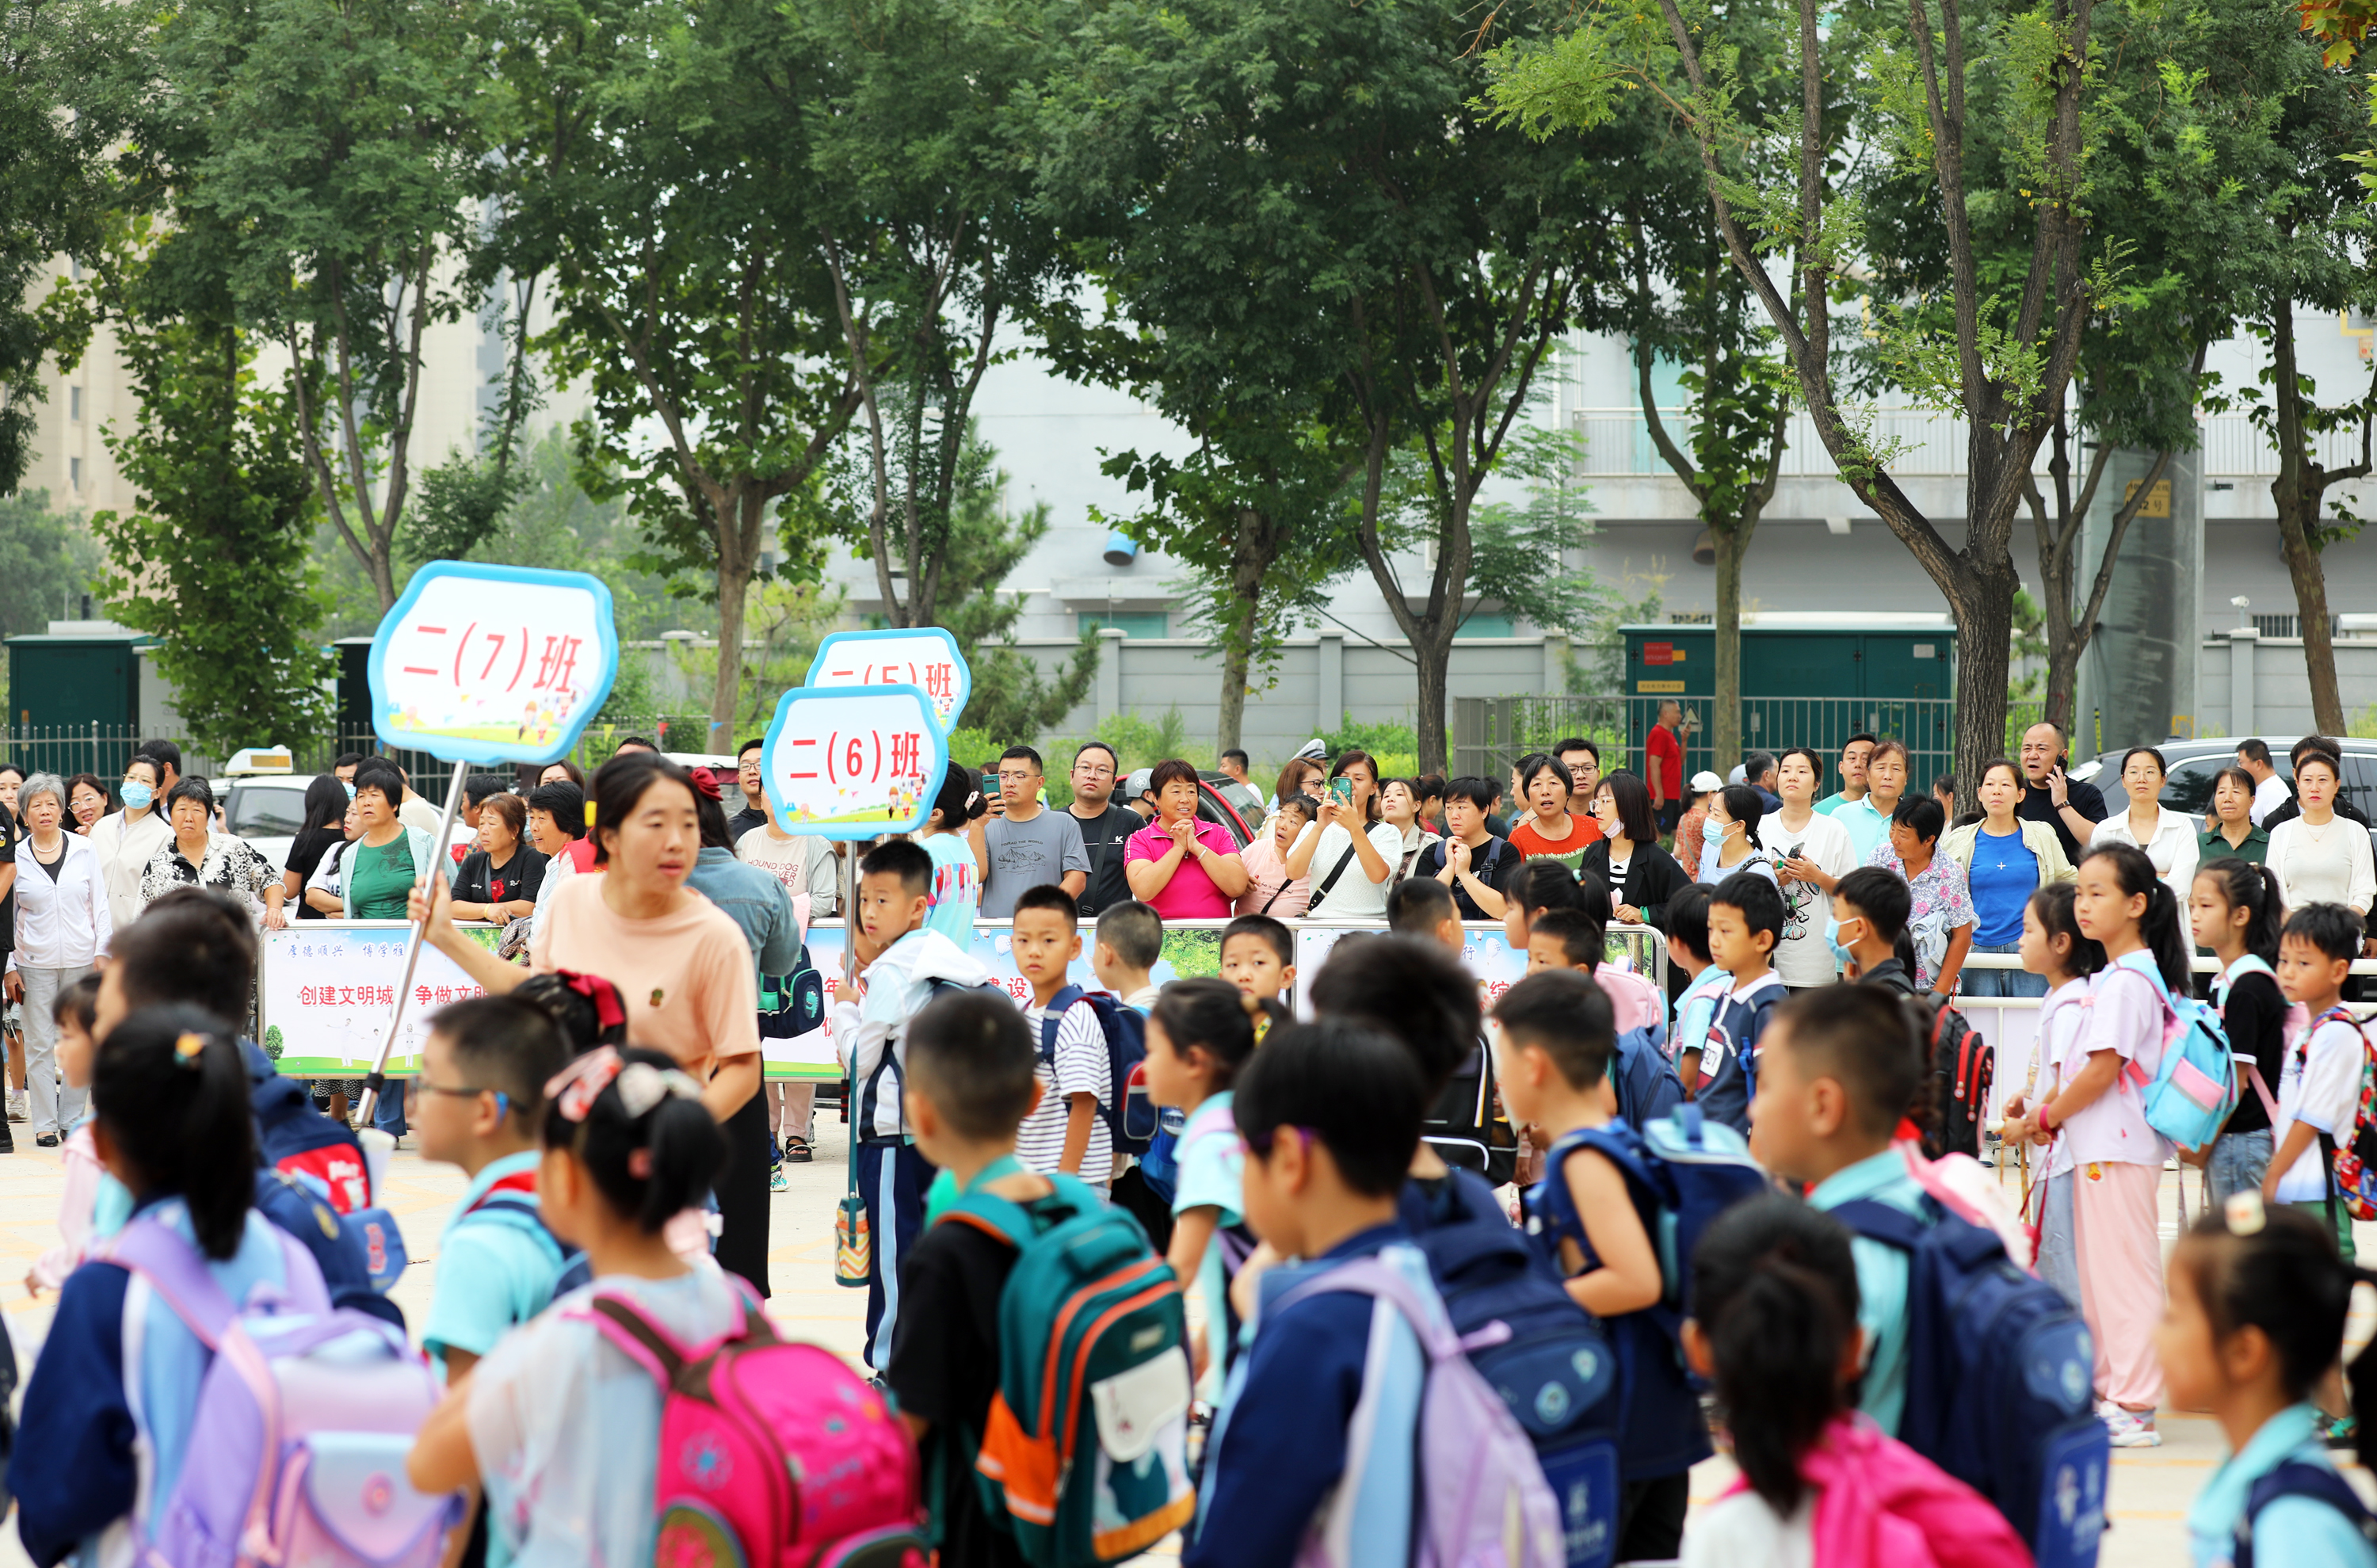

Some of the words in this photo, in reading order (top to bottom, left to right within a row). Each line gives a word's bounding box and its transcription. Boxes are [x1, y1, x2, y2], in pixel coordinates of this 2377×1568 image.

[403, 622, 582, 692] 二(7)班
[790, 730, 921, 784] 二(6)班
[747, 860, 777, 870] HOUND
[779, 863, 799, 872] DOG
[286, 943, 344, 958] 厚德顺兴
